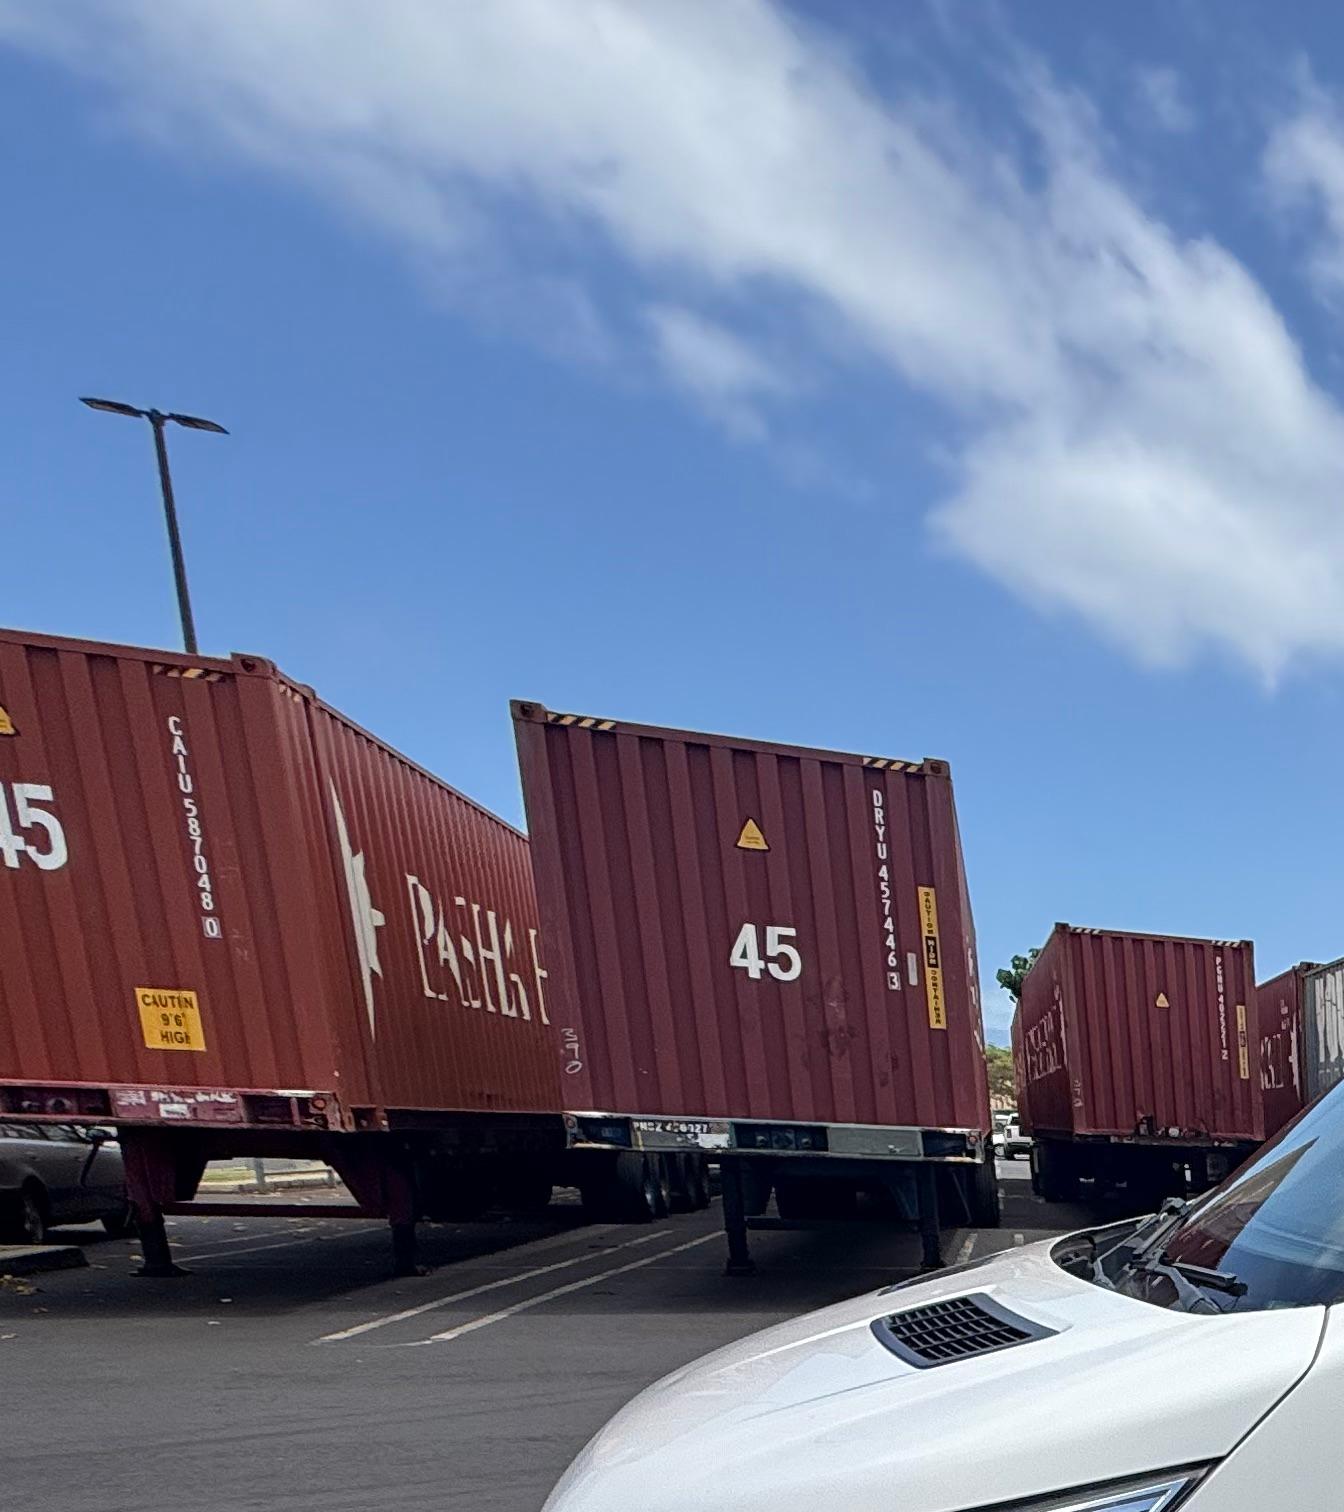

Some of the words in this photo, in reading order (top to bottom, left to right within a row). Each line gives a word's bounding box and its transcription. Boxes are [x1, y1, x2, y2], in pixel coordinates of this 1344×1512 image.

[168, 715, 193, 793] CAIU
[184, 798, 214, 911] 587048
[204, 918, 219, 937] 0
[872, 789, 888, 860] DRYU
[878, 864, 898, 968] 457446
[729, 922, 802, 982] 45
[889, 972, 900, 989] 3
[141, 993, 194, 1009] CAUTIN
